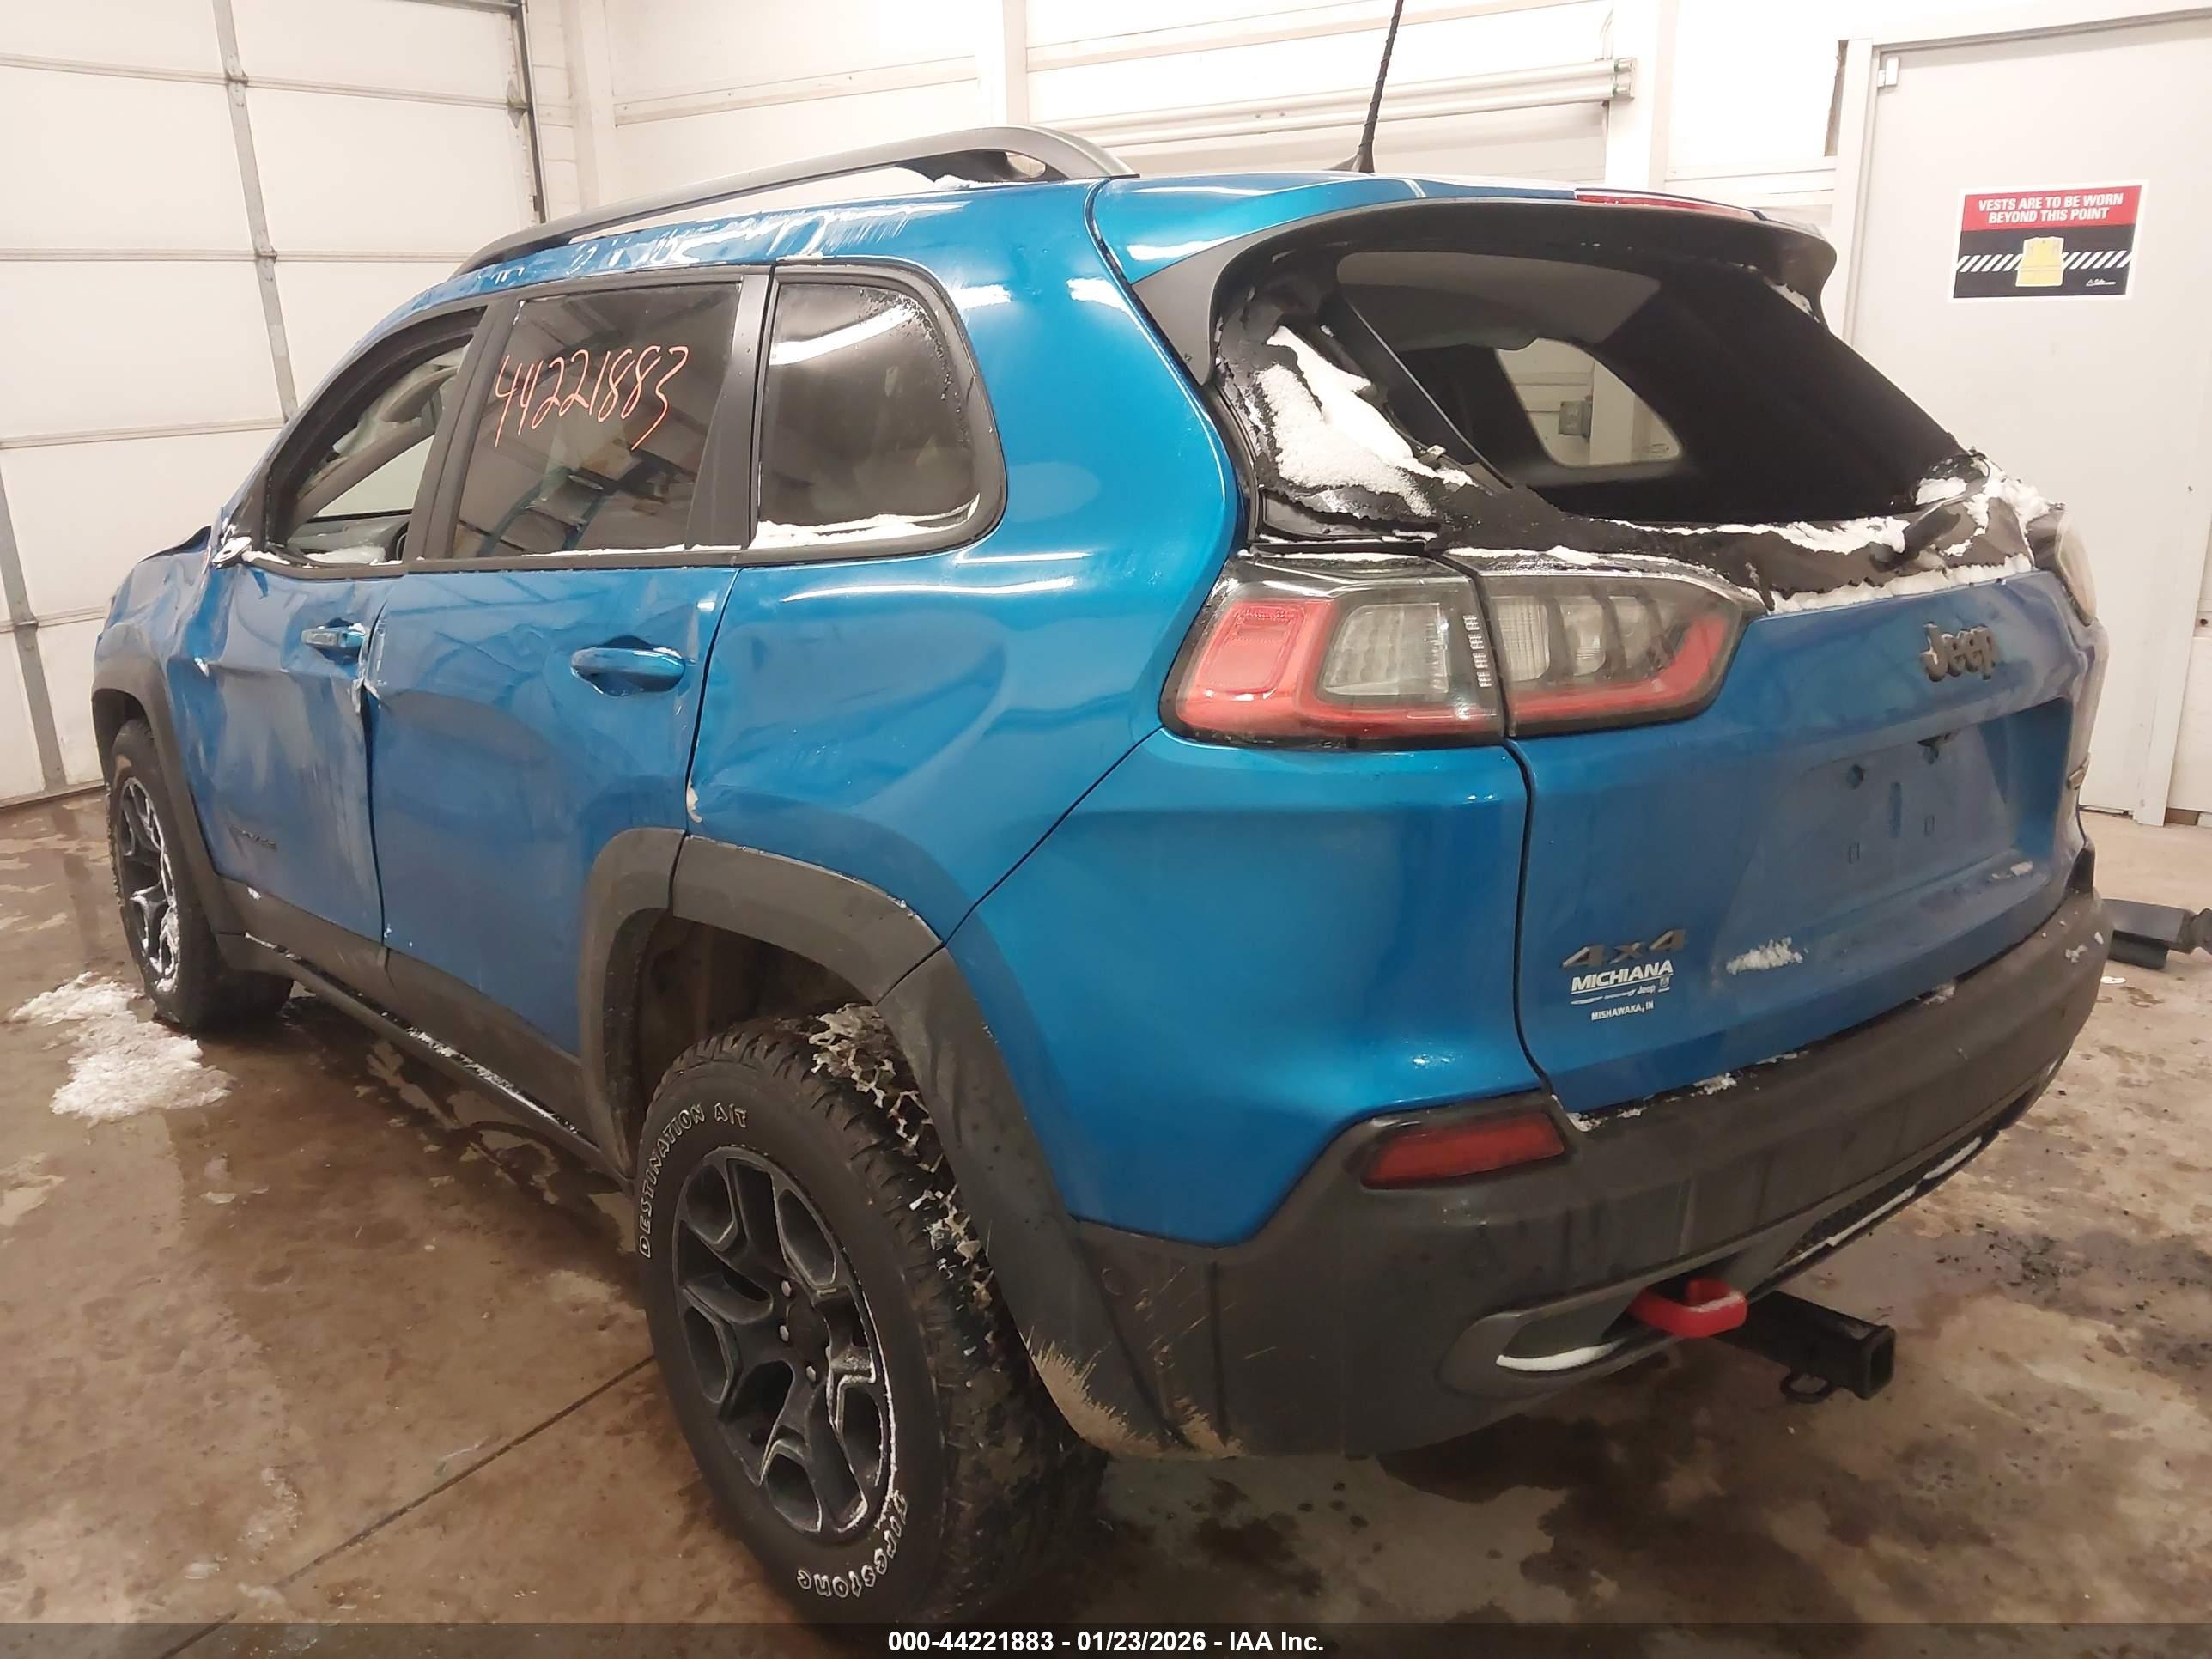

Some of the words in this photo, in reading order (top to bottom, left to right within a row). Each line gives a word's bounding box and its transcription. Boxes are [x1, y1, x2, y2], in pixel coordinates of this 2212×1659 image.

[1978, 199, 2015, 211] VESTS
[2018, 198, 2042, 210] ARE
[2045, 196, 2062, 208] TO
[2064, 195, 2081, 207] BE
[2083, 193, 2124, 206] WORN
[1988, 210, 2038, 224] BEYOND
[2040, 209, 2068, 221] THIS
[2070, 207, 2110, 221] POINT
[495, 345, 689, 451] 44221883
[1920, 621, 1996, 681] Jeep
[1571, 960, 1674, 991] MICHIANA
[1590, 1003, 1644, 1021] MISHAWAKA,
[1645, 1000, 1655, 1010] IN
[639, 1103, 705, 1258] DESTINATION
[714, 1102, 747, 1128] A/T
[797, 1489, 908, 1598] Firestone
